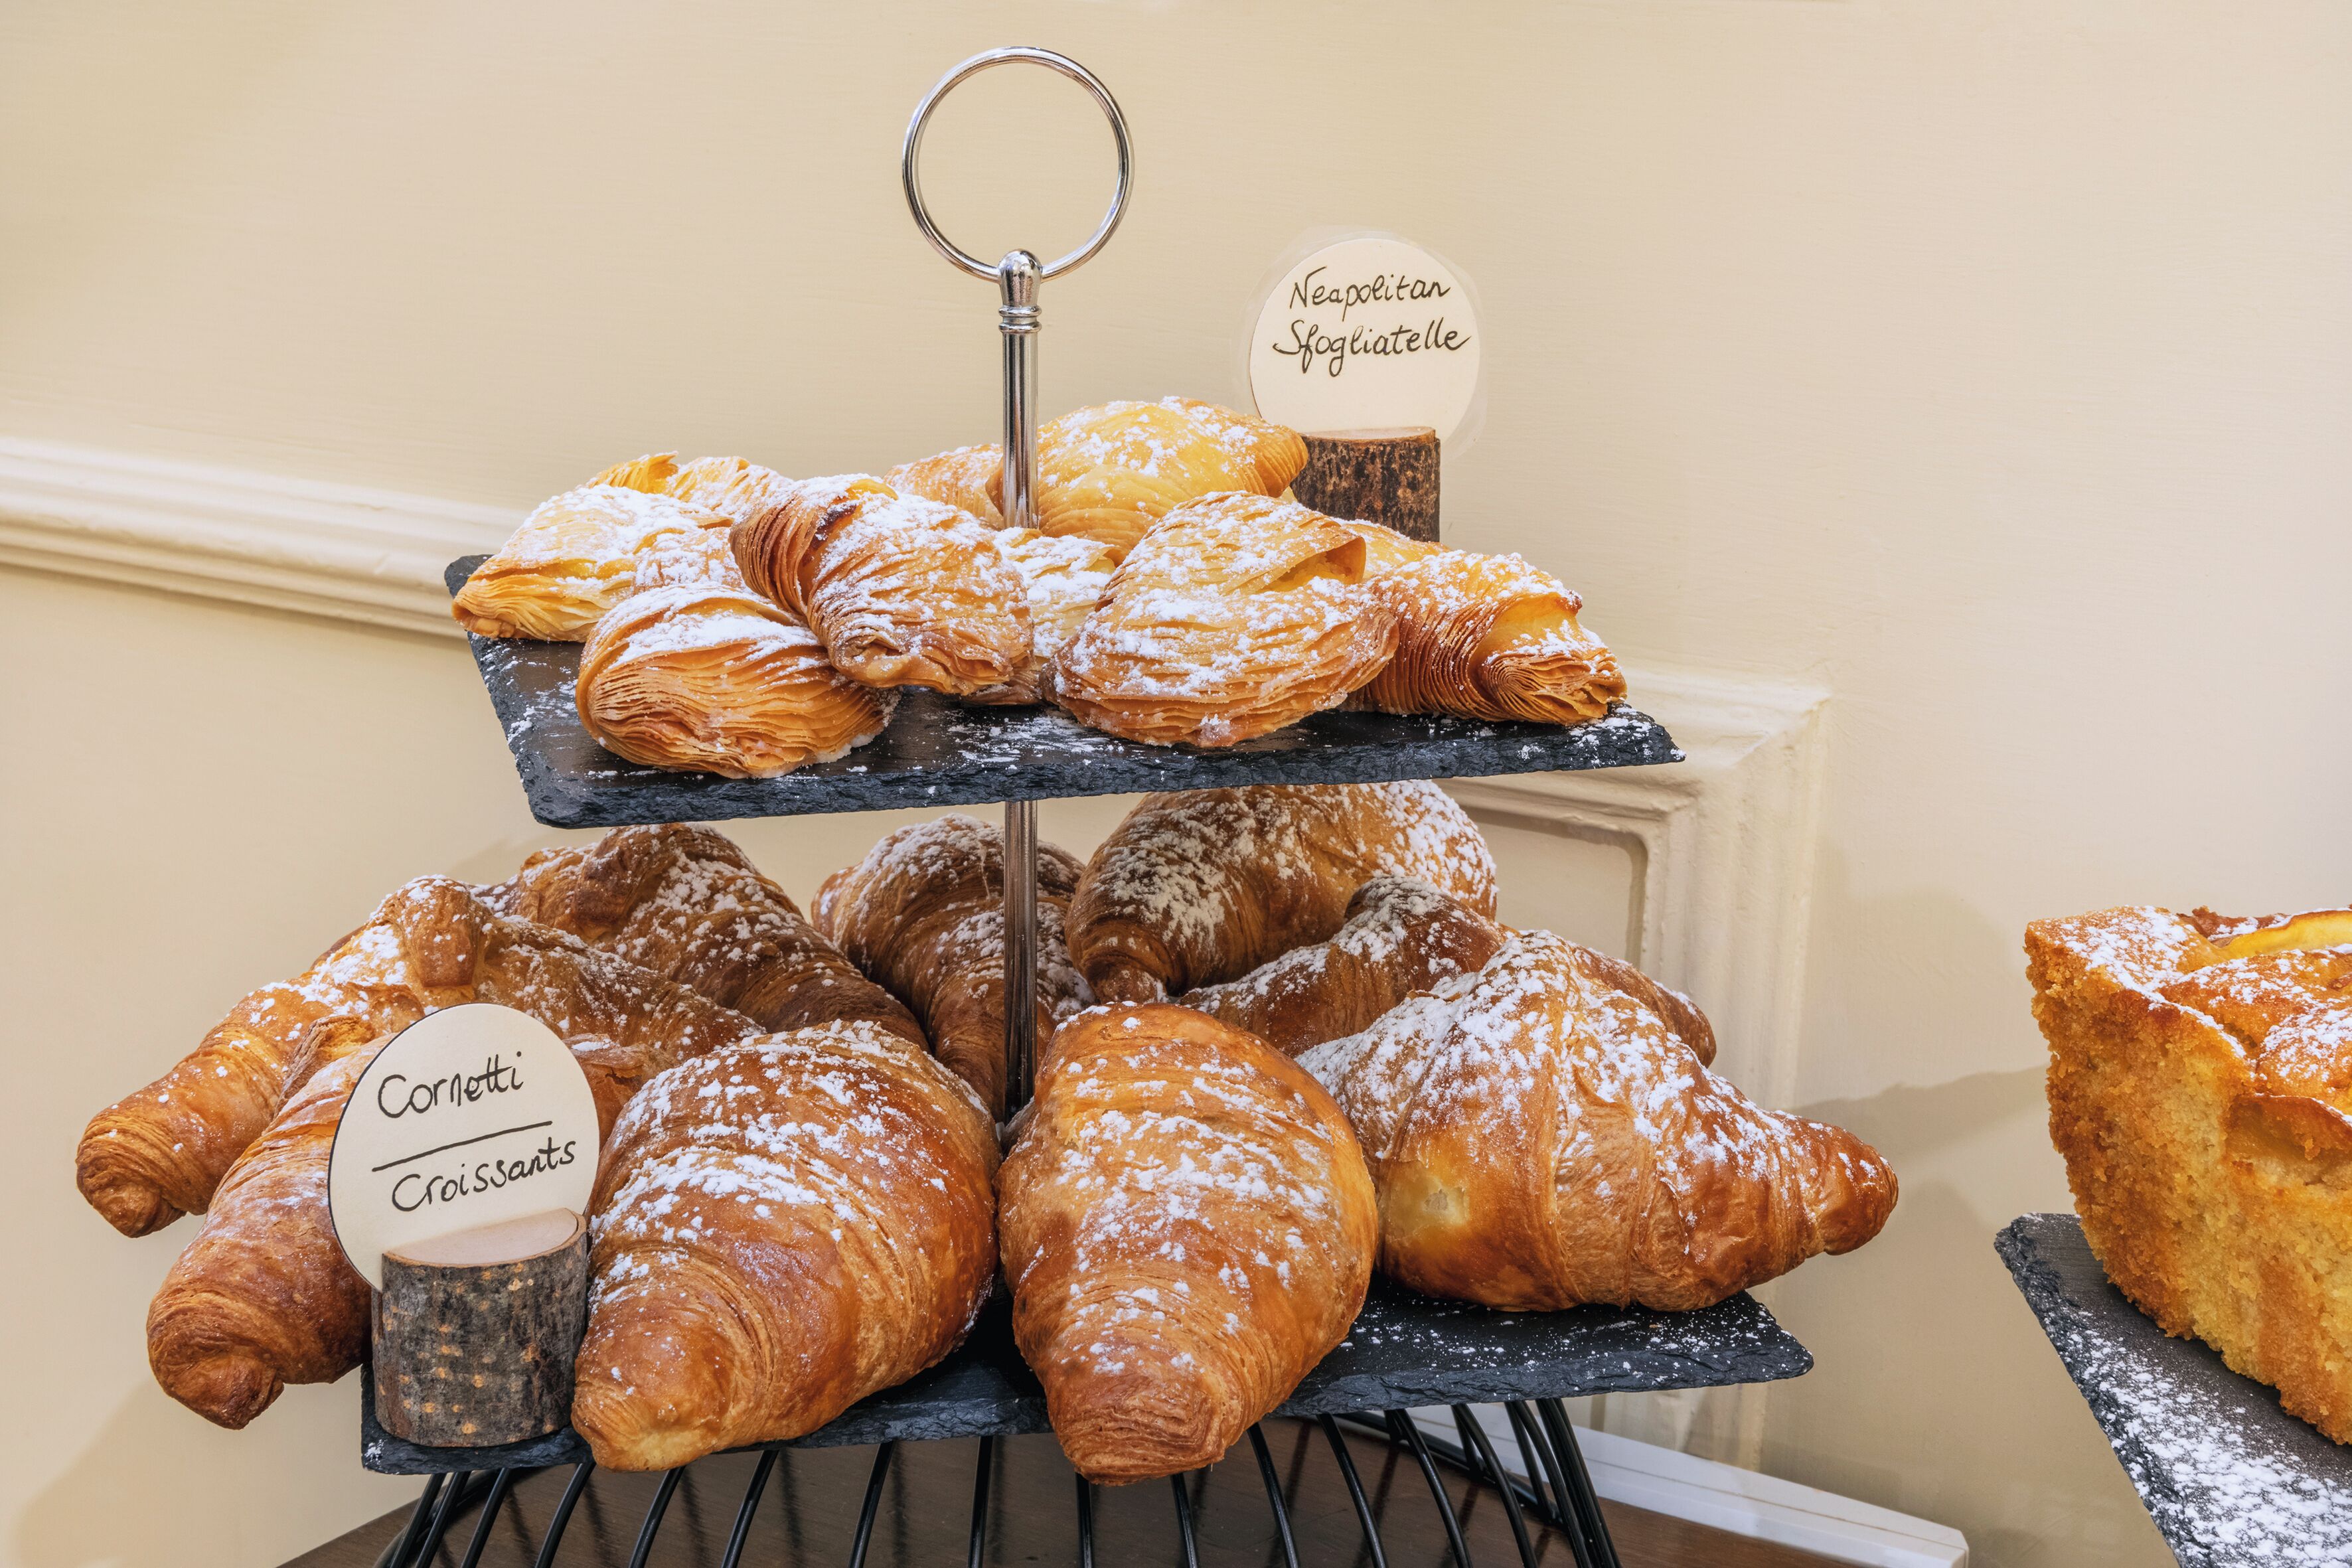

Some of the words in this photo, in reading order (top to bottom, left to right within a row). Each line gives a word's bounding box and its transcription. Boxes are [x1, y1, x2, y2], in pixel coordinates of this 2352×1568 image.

[1290, 265, 1450, 322] Neapolitan
[1273, 317, 1472, 377] Sfogliatelle
[378, 1051, 524, 1119] Cornetti
[392, 1137, 576, 1212] Croissants
